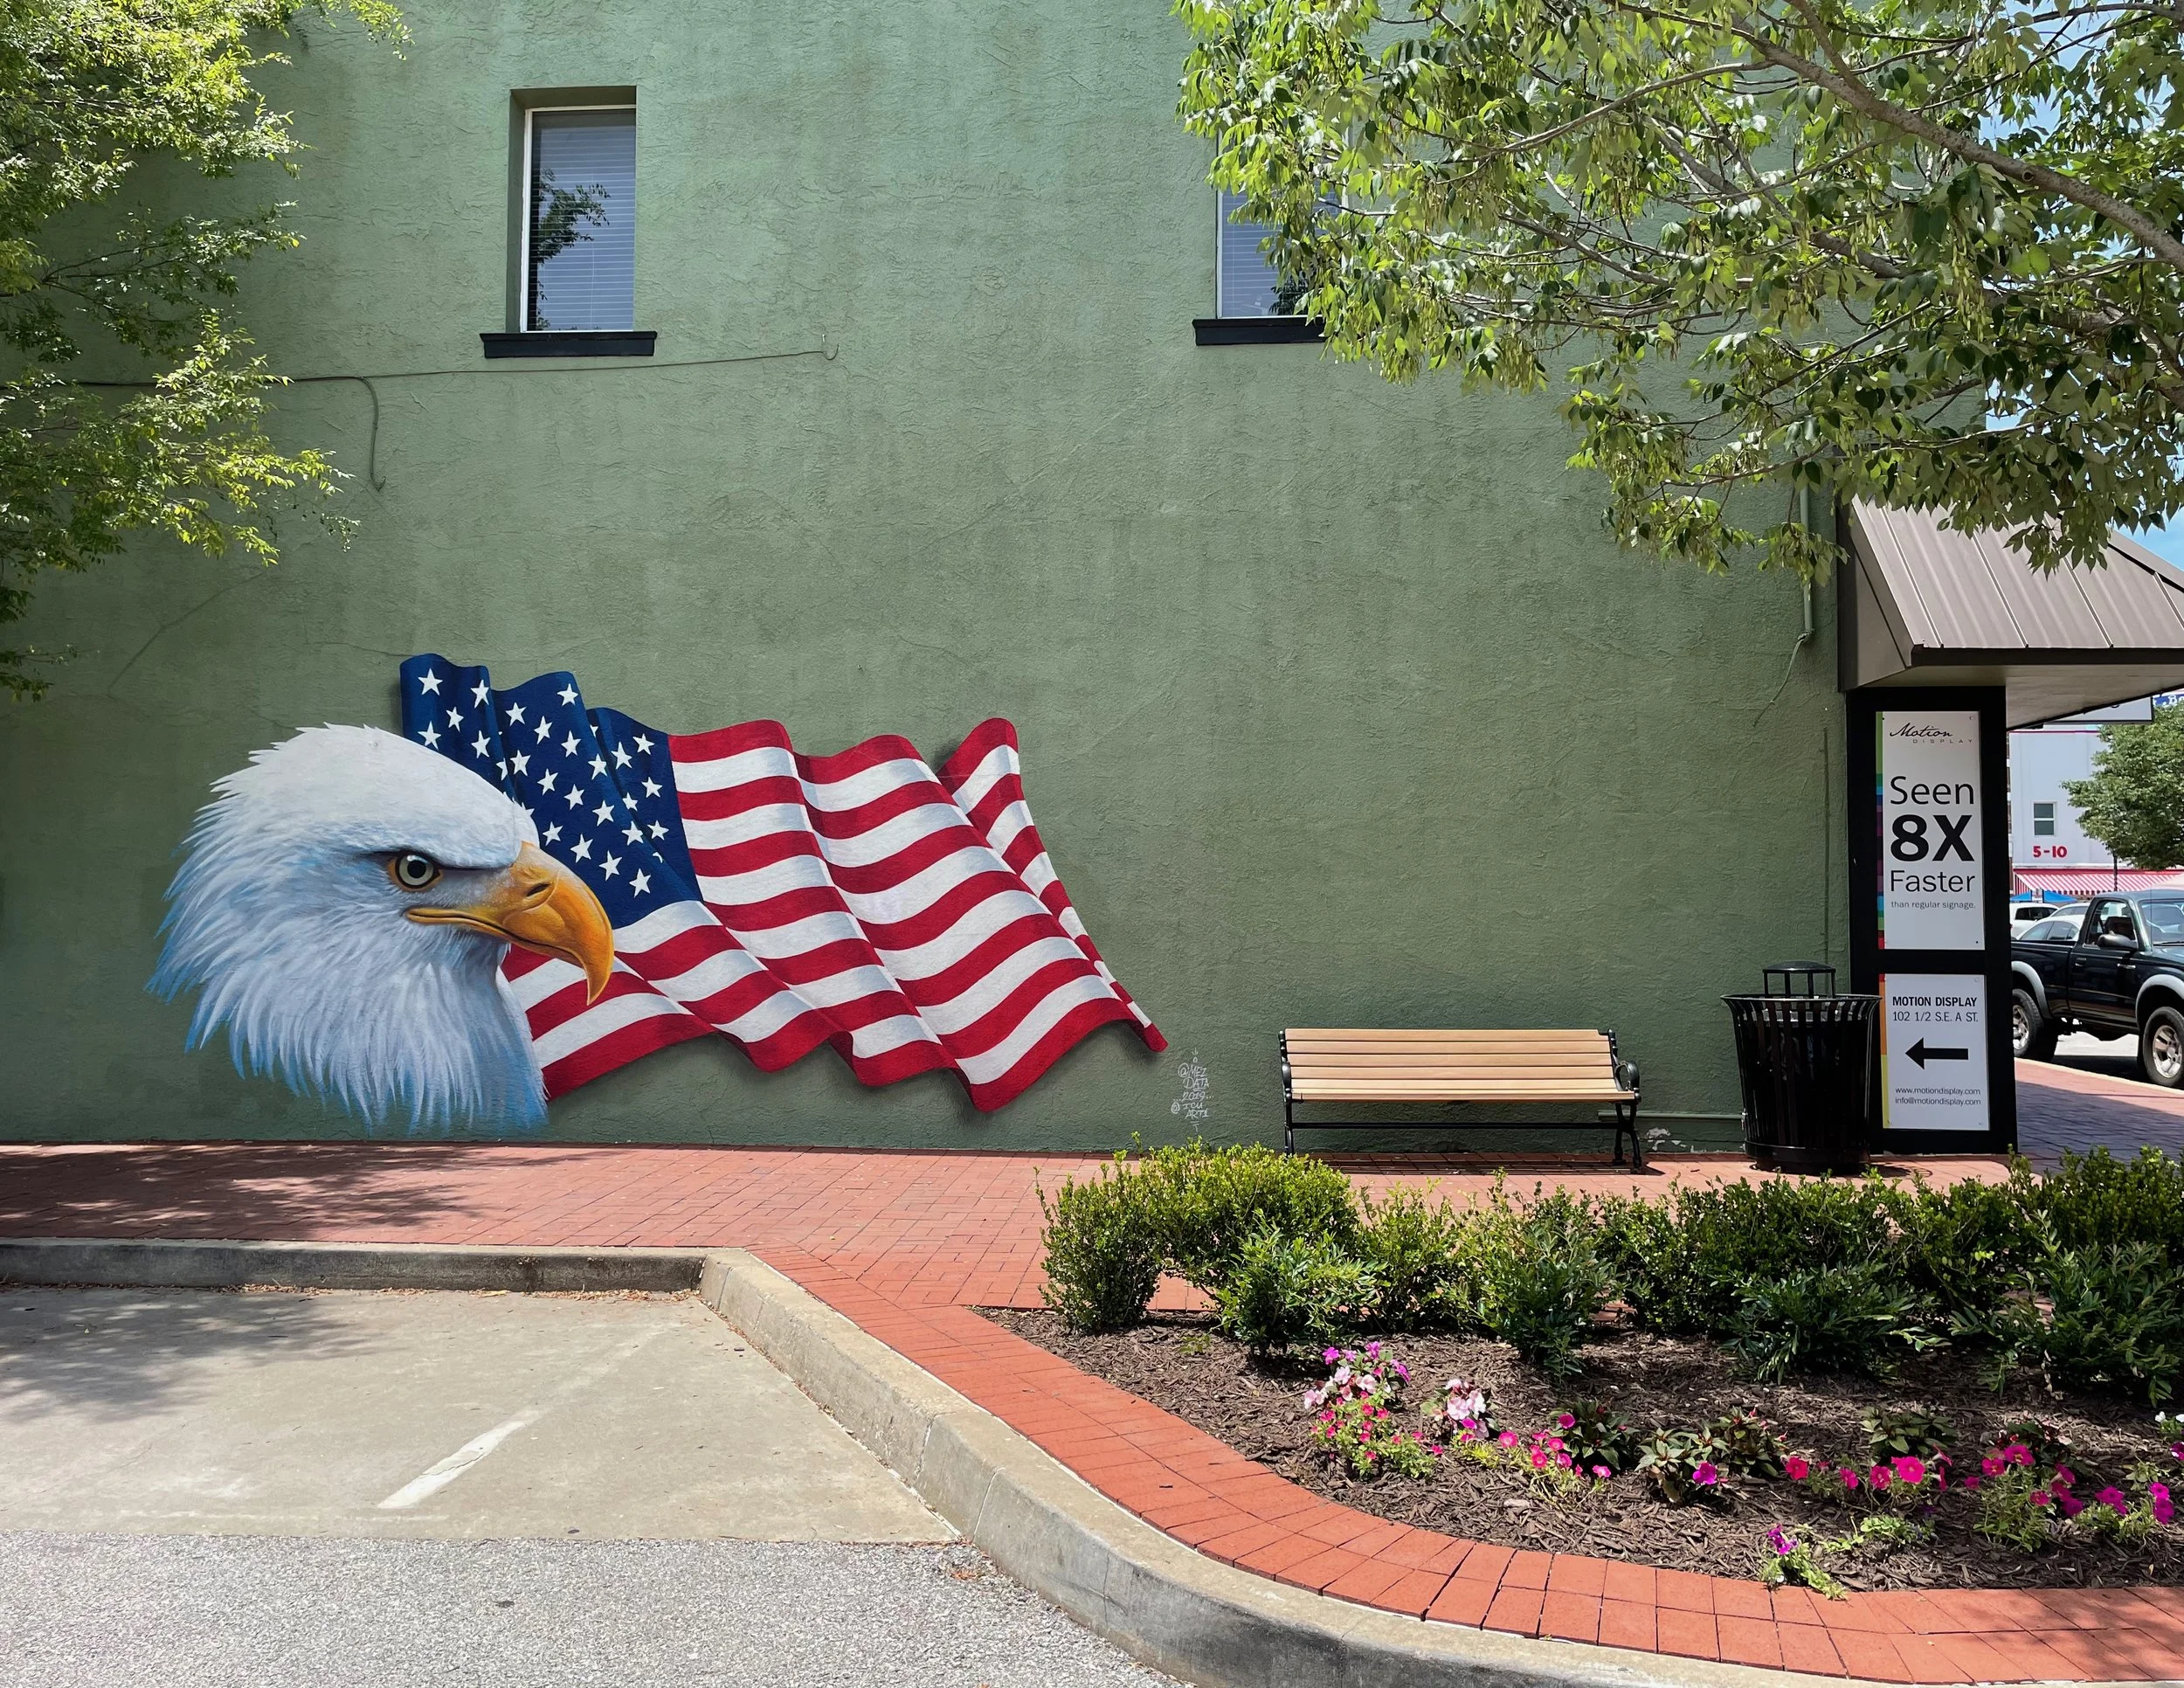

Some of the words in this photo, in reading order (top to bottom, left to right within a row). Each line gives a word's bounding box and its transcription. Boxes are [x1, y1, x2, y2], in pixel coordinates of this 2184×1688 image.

[1889, 722, 1953, 737] Motion
[1890, 775, 1974, 805] Seen
[1890, 814, 1975, 862] 8X
[2033, 845, 2068, 858] 5-10
[1890, 869, 1976, 893] Faster
[1890, 900, 1910, 909] than
[1911, 901, 1940, 910] regular
[1892, 996, 1932, 1007] MOTION
[1935, 996, 1978, 1007] DISPLAY
[1892, 1011, 1911, 1021] 102
[1915, 1011, 1932, 1021] 1/2
[1935, 1012, 1952, 1022] S.E.
[1955, 1012, 1962, 1021] A
[1966, 1012, 1979, 1022] ST.
[1895, 1087, 1981, 1096] www.motiondisplay.com
[1895, 1097, 1981, 1106] info@motiondisplay.com
